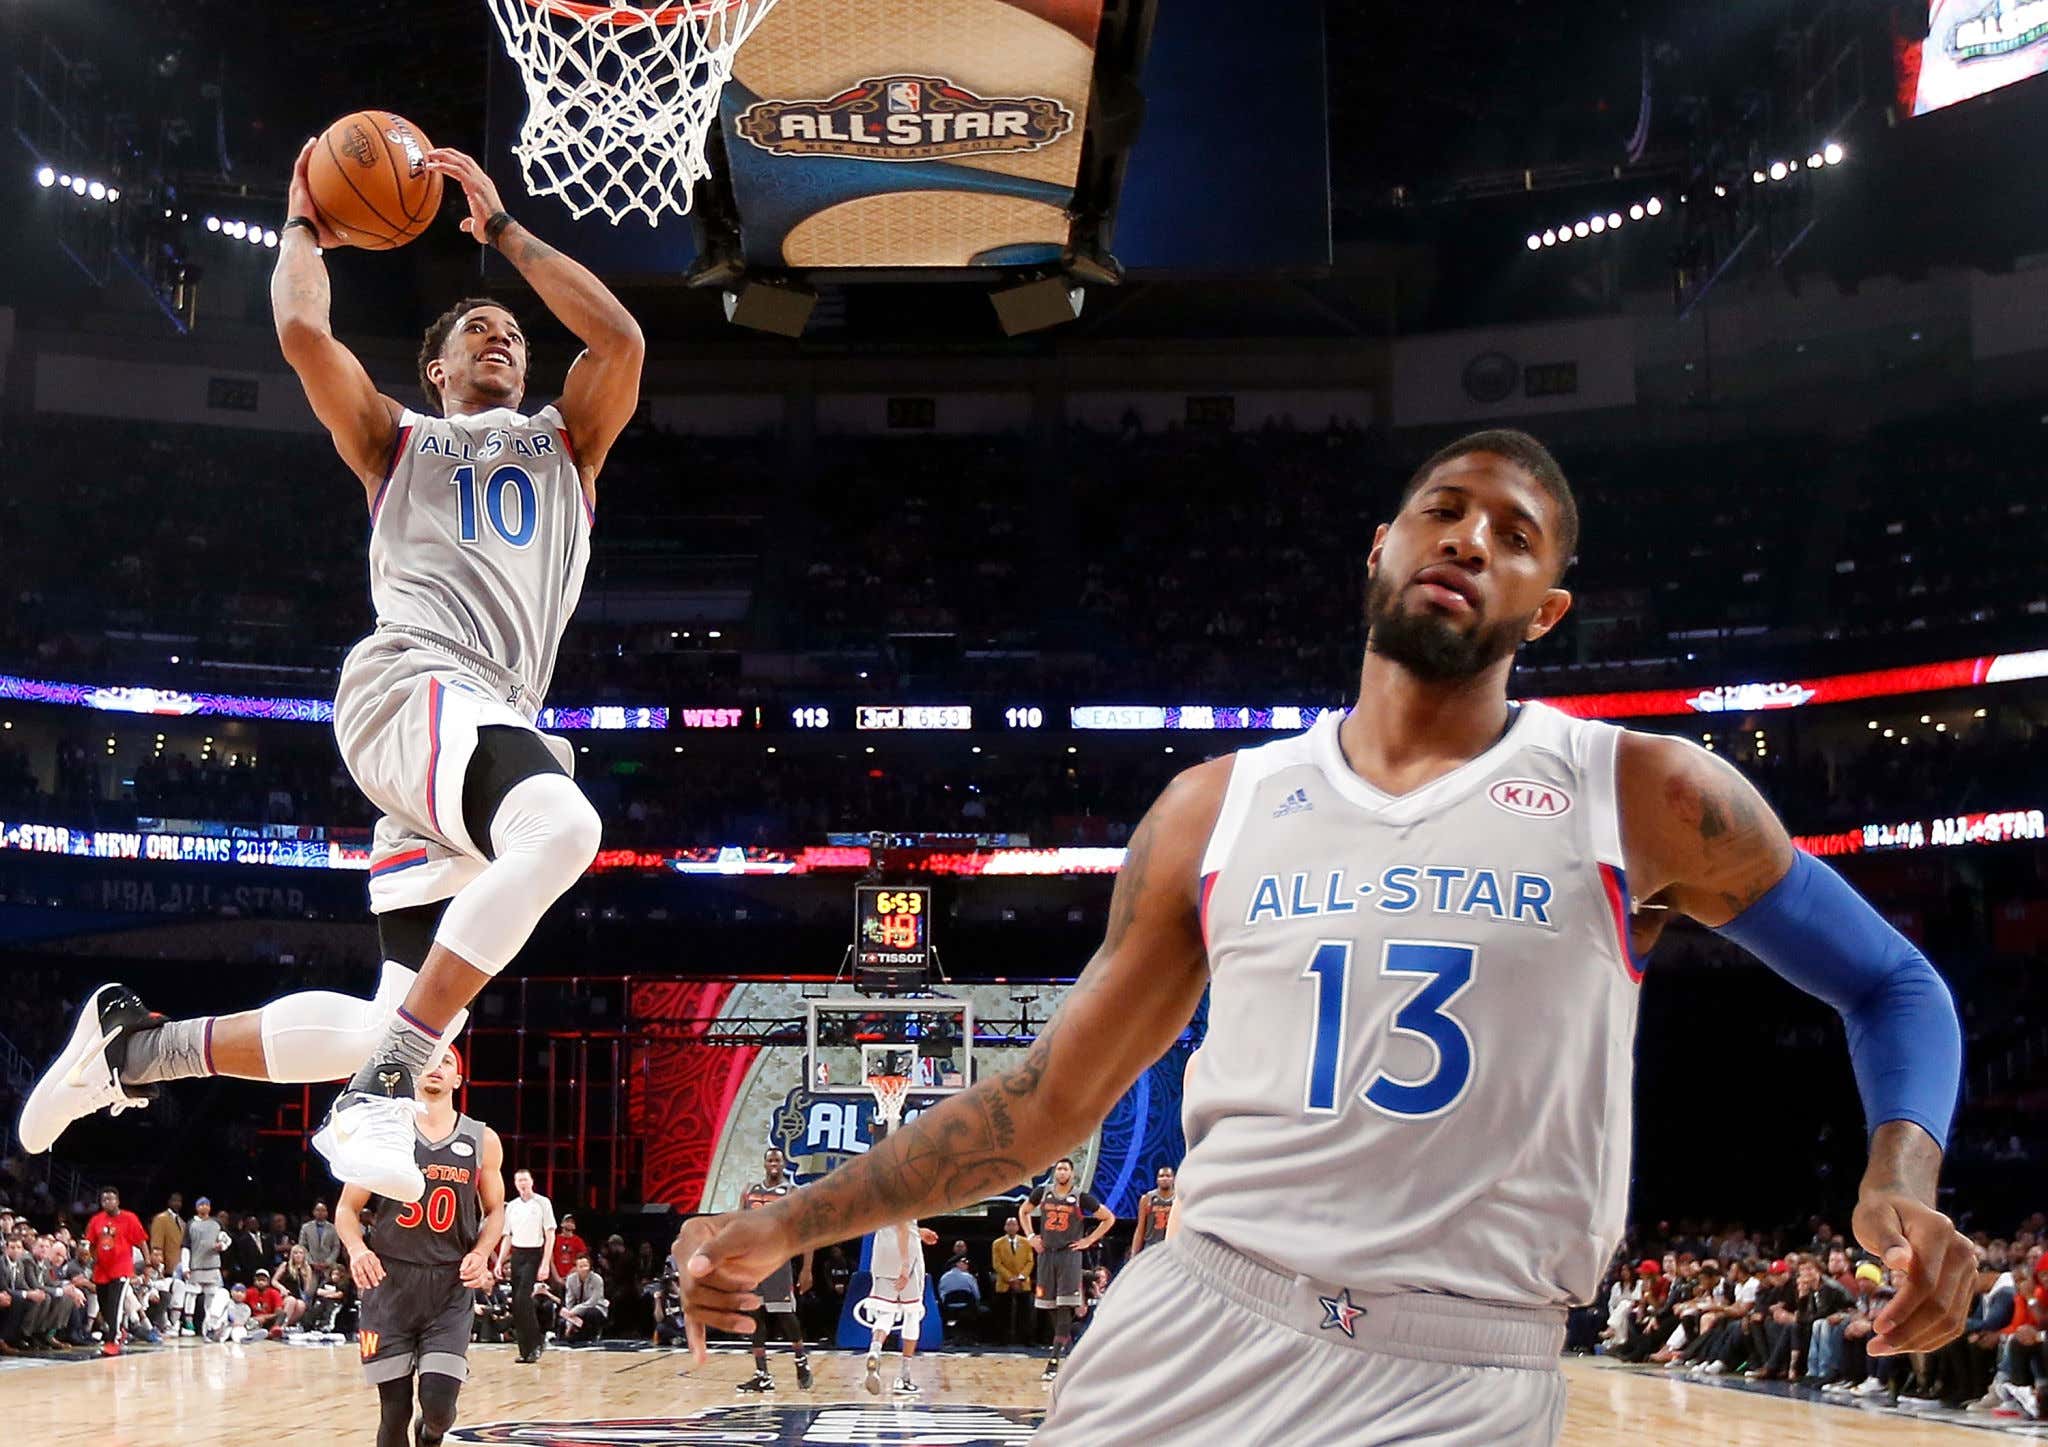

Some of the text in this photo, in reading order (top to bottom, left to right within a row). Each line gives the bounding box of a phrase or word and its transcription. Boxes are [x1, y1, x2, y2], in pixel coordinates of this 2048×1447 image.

[450, 463, 539, 550] 10
[683, 708, 743, 728] WEST
[792, 707, 830, 728] 113
[863, 707, 900, 729] 3rd
[1005, 707, 1042, 728] 110
[1092, 709, 1145, 726] EAST
[1503, 786, 1555, 811] KIA
[19, 825, 70, 854] STAR
[94, 832, 142, 859] NEW
[146, 834, 231, 862] ORLEANS
[877, 892, 921, 914] 6:53
[878, 953, 925, 964] TISSOT
[1303, 939, 1480, 1120] 13
[1044, 1211, 1070, 1232] 23
